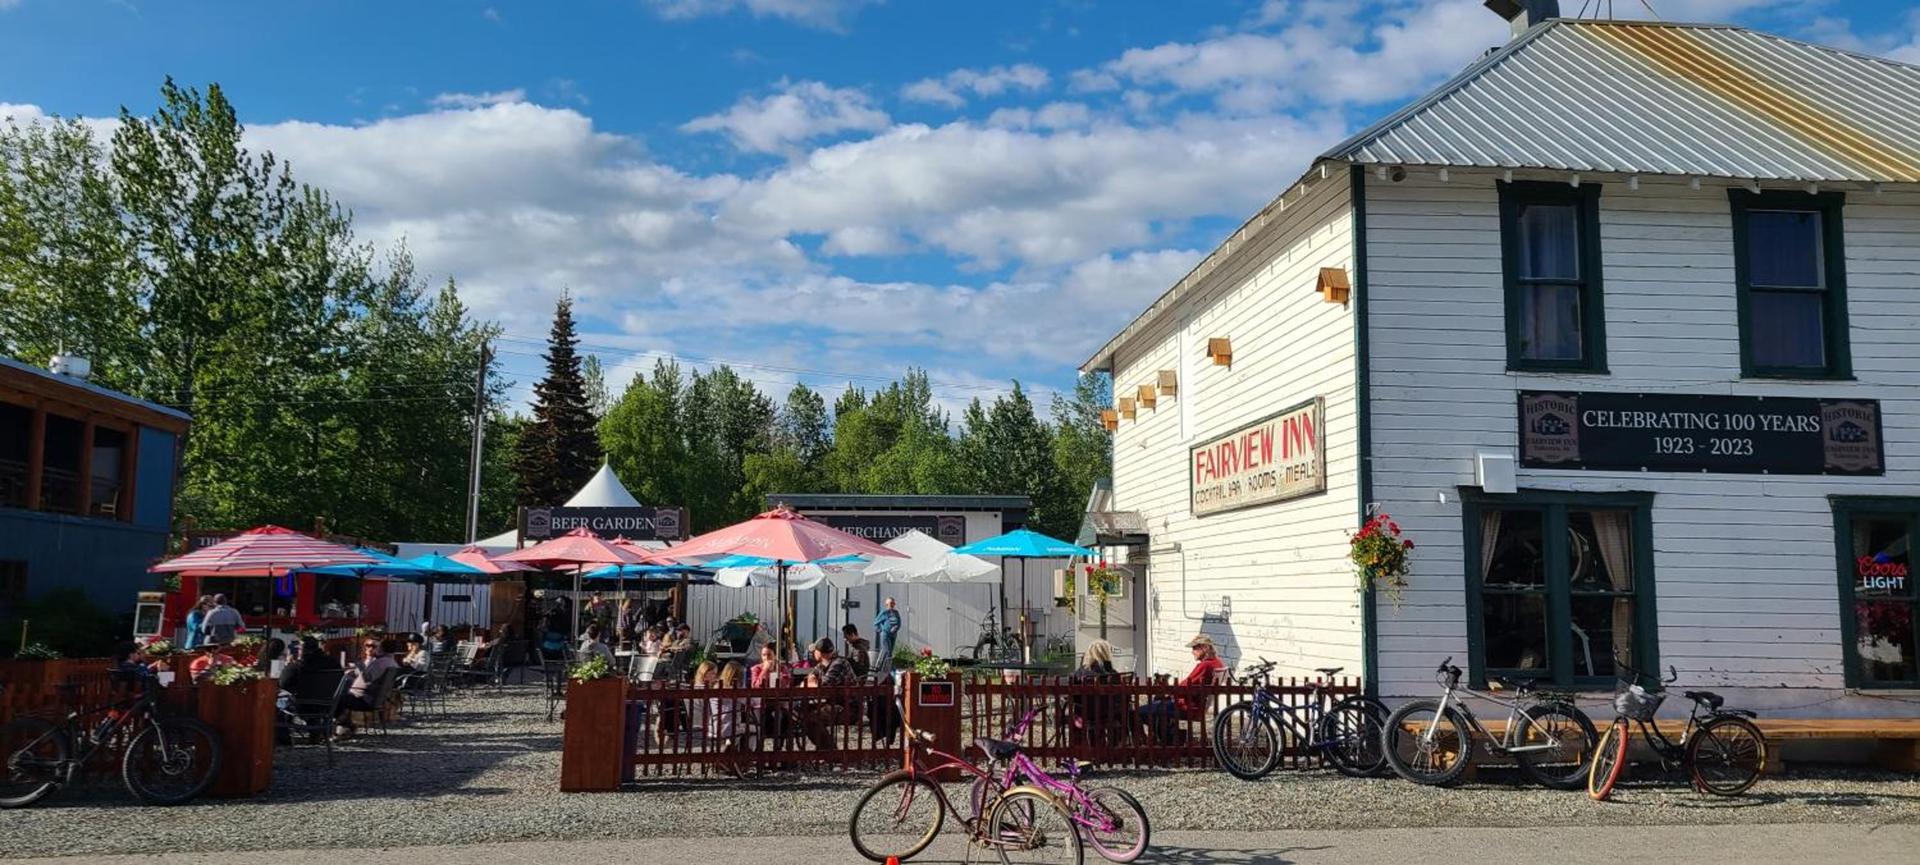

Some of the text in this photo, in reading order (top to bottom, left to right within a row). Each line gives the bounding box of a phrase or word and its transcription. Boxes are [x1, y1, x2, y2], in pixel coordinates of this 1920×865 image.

[1582, 410, 1821, 432] CELEBRATING 100 YEARS
[1196, 408, 1316, 485] FAIRVIEW INN
[1654, 437, 1695, 454] 1923
[1711, 438, 1754, 455] 2023
[1248, 470, 1276, 491] ROOMS
[552, 517, 589, 530] BEER
[593, 517, 656, 530] GARDEN
[835, 526, 933, 538] ERCHANDSE
[1856, 555, 1907, 576] Coors
[1863, 576, 1905, 589] LIGHT
